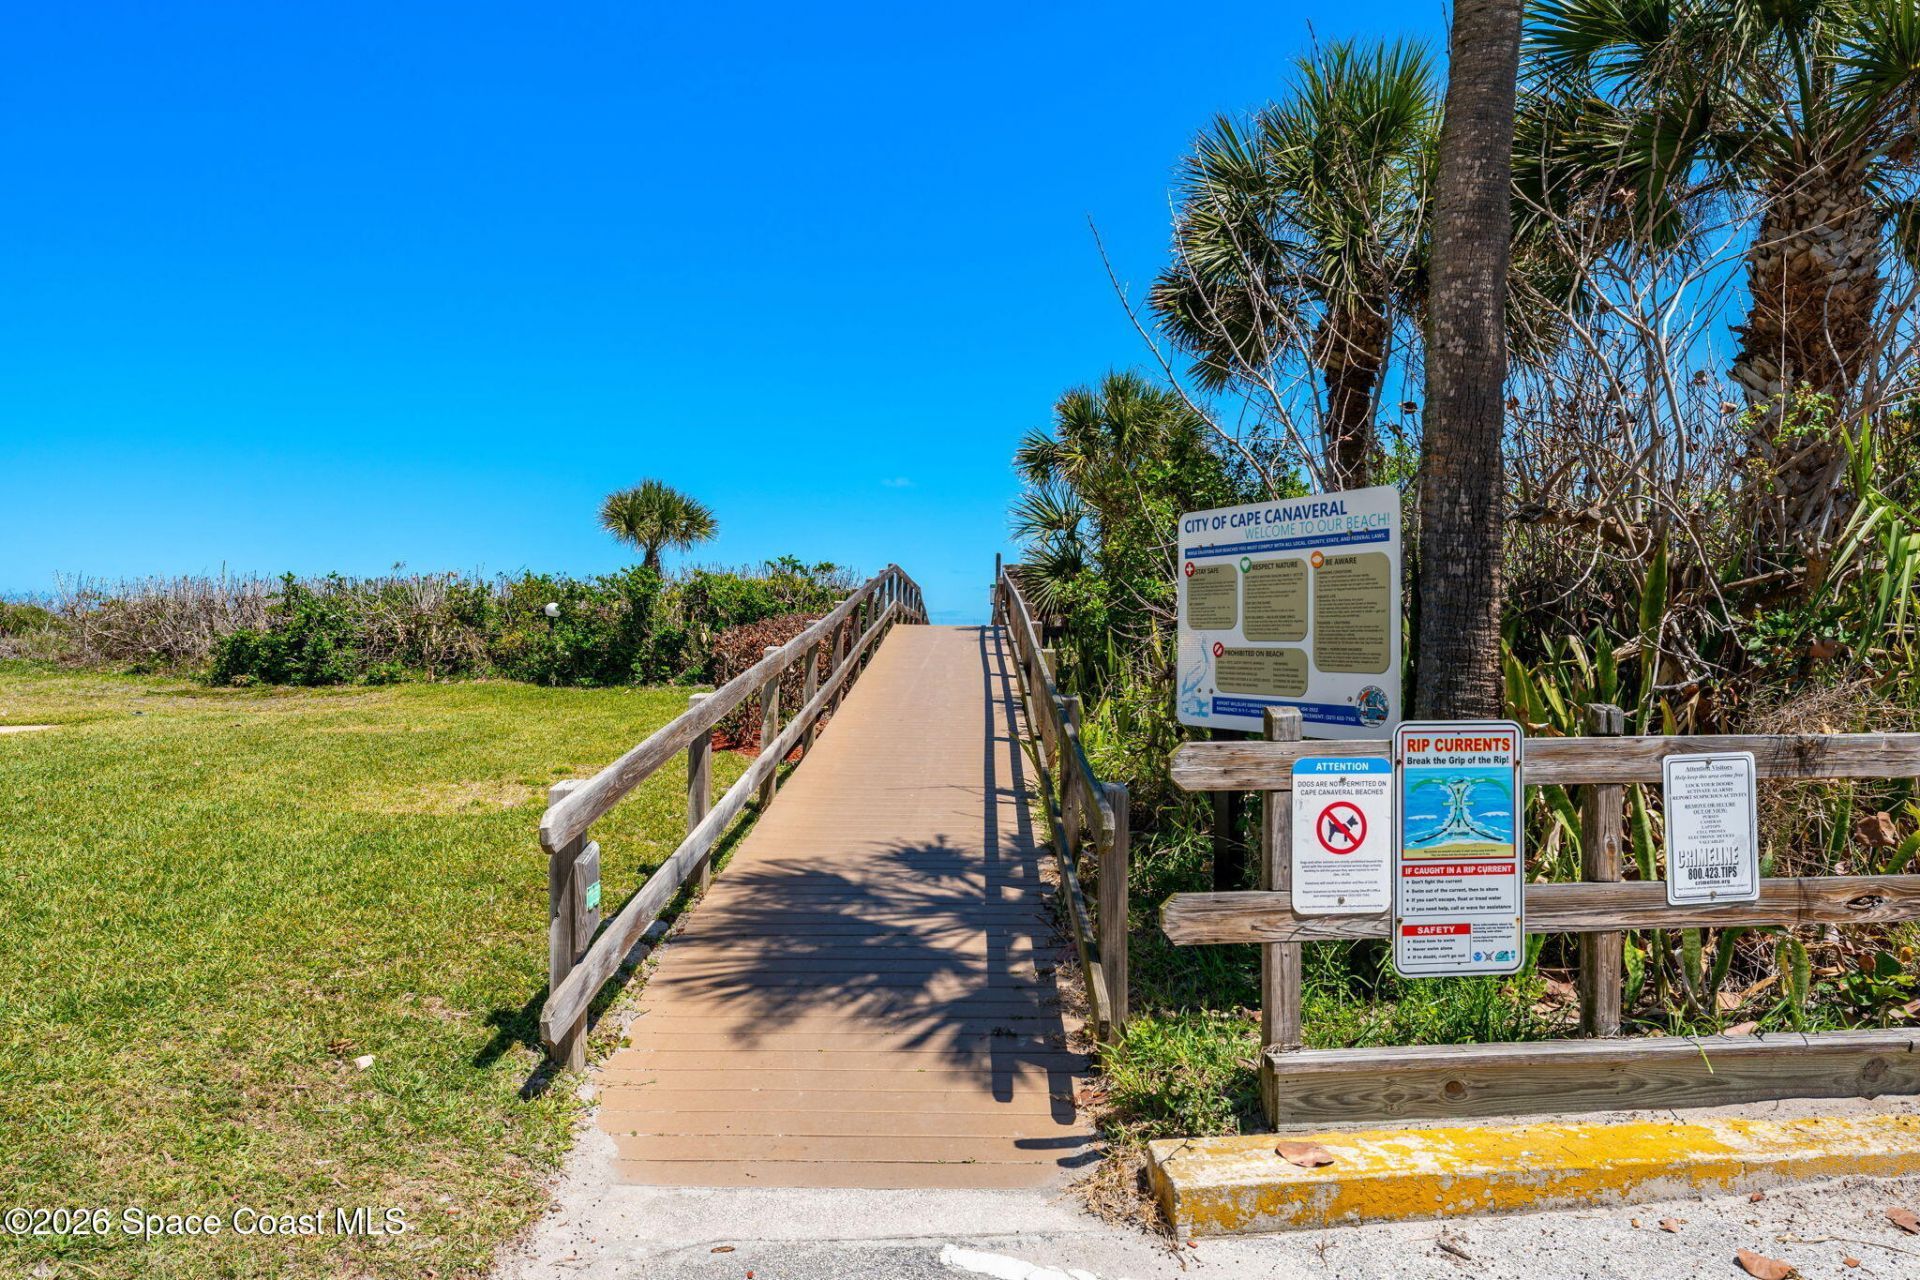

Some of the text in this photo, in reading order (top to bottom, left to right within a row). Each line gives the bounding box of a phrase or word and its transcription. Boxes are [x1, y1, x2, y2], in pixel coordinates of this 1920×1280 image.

[1185, 500, 1348, 533] CITY OF CAPE CANAVERAL
[1245, 512, 1391, 540] WELCOME TO OUR BEACH!
[1334, 557, 1357, 565] AWARE
[1253, 563, 1274, 571] RESPECT
[1407, 738, 1511, 752] RIP CURRENTS
[1407, 755, 1509, 766] Break the Grip of the Rip!
[1316, 762, 1369, 771] ATTENTION
[1329, 780, 1342, 788] NOT
[1355, 788, 1384, 796] BEACHES
[1678, 846, 1740, 869] CRIMELINE
[1447, 866, 1455, 874] IN
[1478, 865, 1512, 873] CURRENT
[1688, 866, 1738, 880] 800.423.TIPS
[1417, 926, 1456, 934] SAFETY
